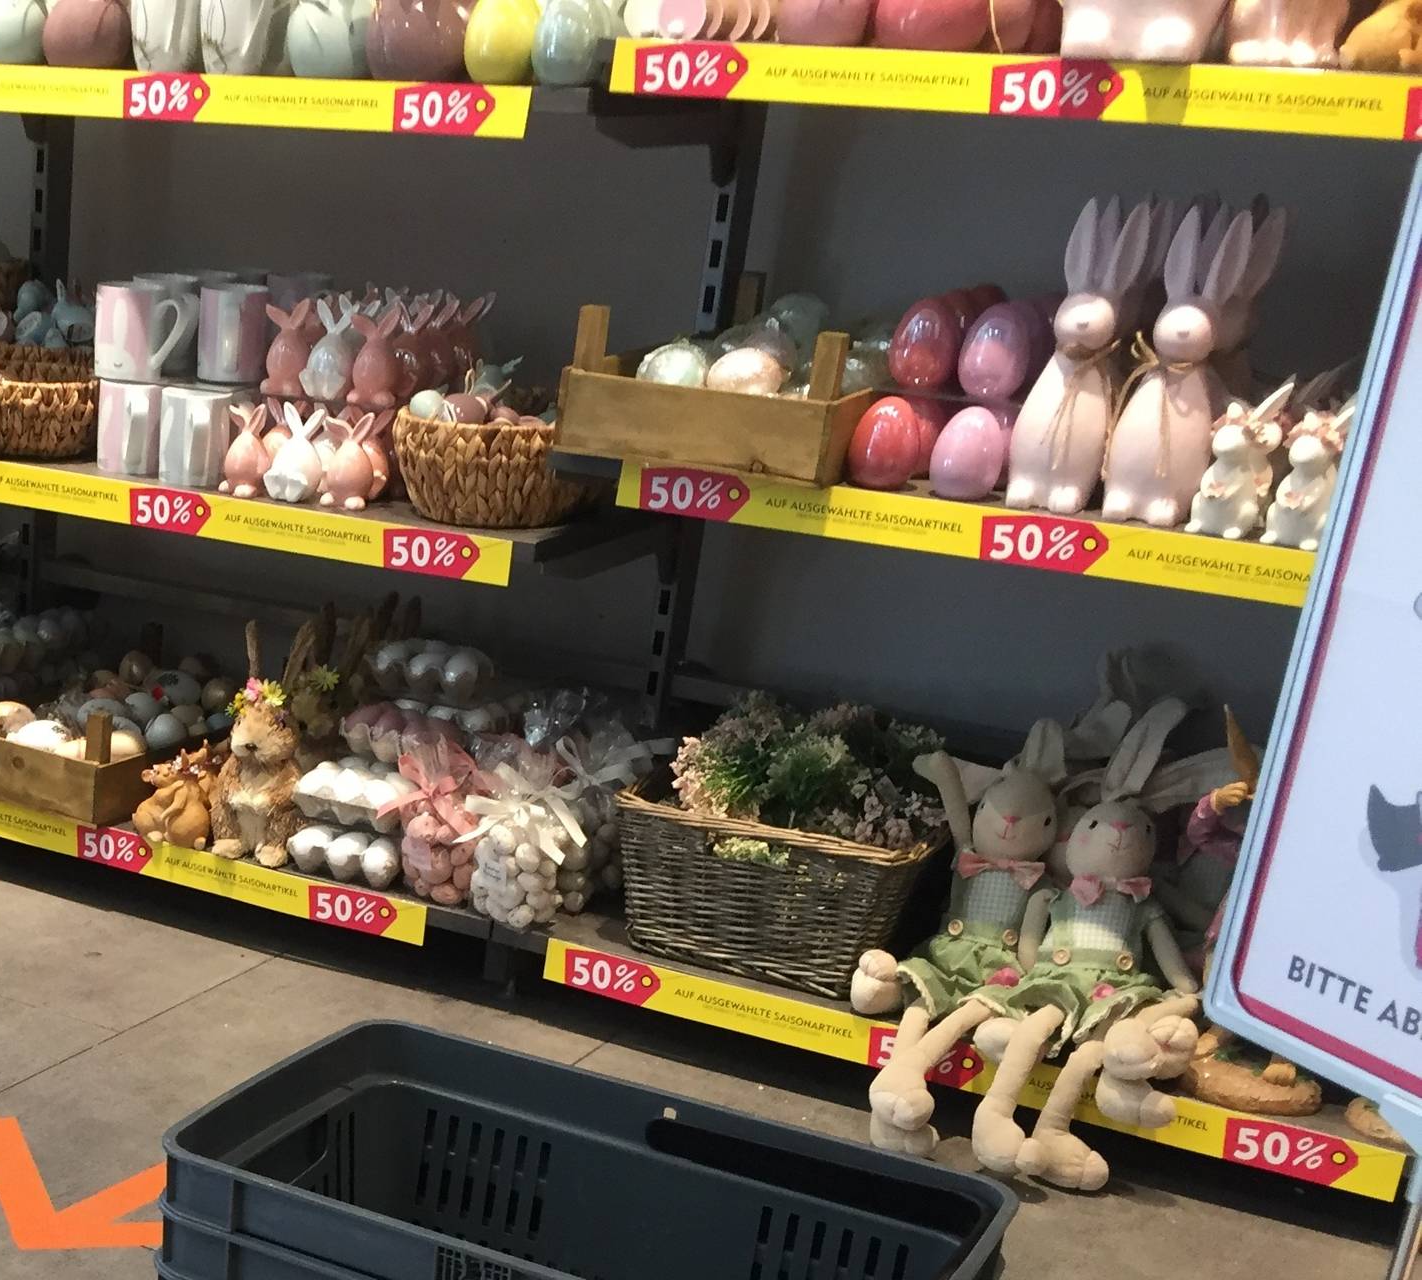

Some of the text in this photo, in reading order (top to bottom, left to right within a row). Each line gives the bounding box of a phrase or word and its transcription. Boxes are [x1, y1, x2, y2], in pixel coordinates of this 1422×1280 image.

[643, 51, 722, 92] 50%
[765, 65, 787, 77] AUF
[129, 79, 190, 118] 50%
[400, 89, 470, 130] 50%
[1000, 69, 1090, 115] 50%
[1143, 87, 1170, 99] AUF
[136, 495, 193, 525] 50%
[649, 476, 724, 510] 50%
[224, 514, 242, 523] AUF
[306, 526, 372, 544] SAISONARTIKEL
[765, 498, 788, 510] AUF
[875, 512, 964, 534] SAISONARTIKEL
[391, 535, 457, 567] 50%
[989, 523, 1080, 562] 50%
[1127, 548, 1153, 561] AUF
[1255, 565, 1311, 583] SAISONA
[83, 832, 136, 863] 50%
[315, 893, 376, 925] 50%
[571, 956, 636, 994] 50%
[674, 989, 695, 1000] AUF
[773, 1011, 854, 1040] SAISONARTIKEL
[1287, 954, 1422, 1042] BITTE AB
[1233, 1127, 1328, 1172] 50%
